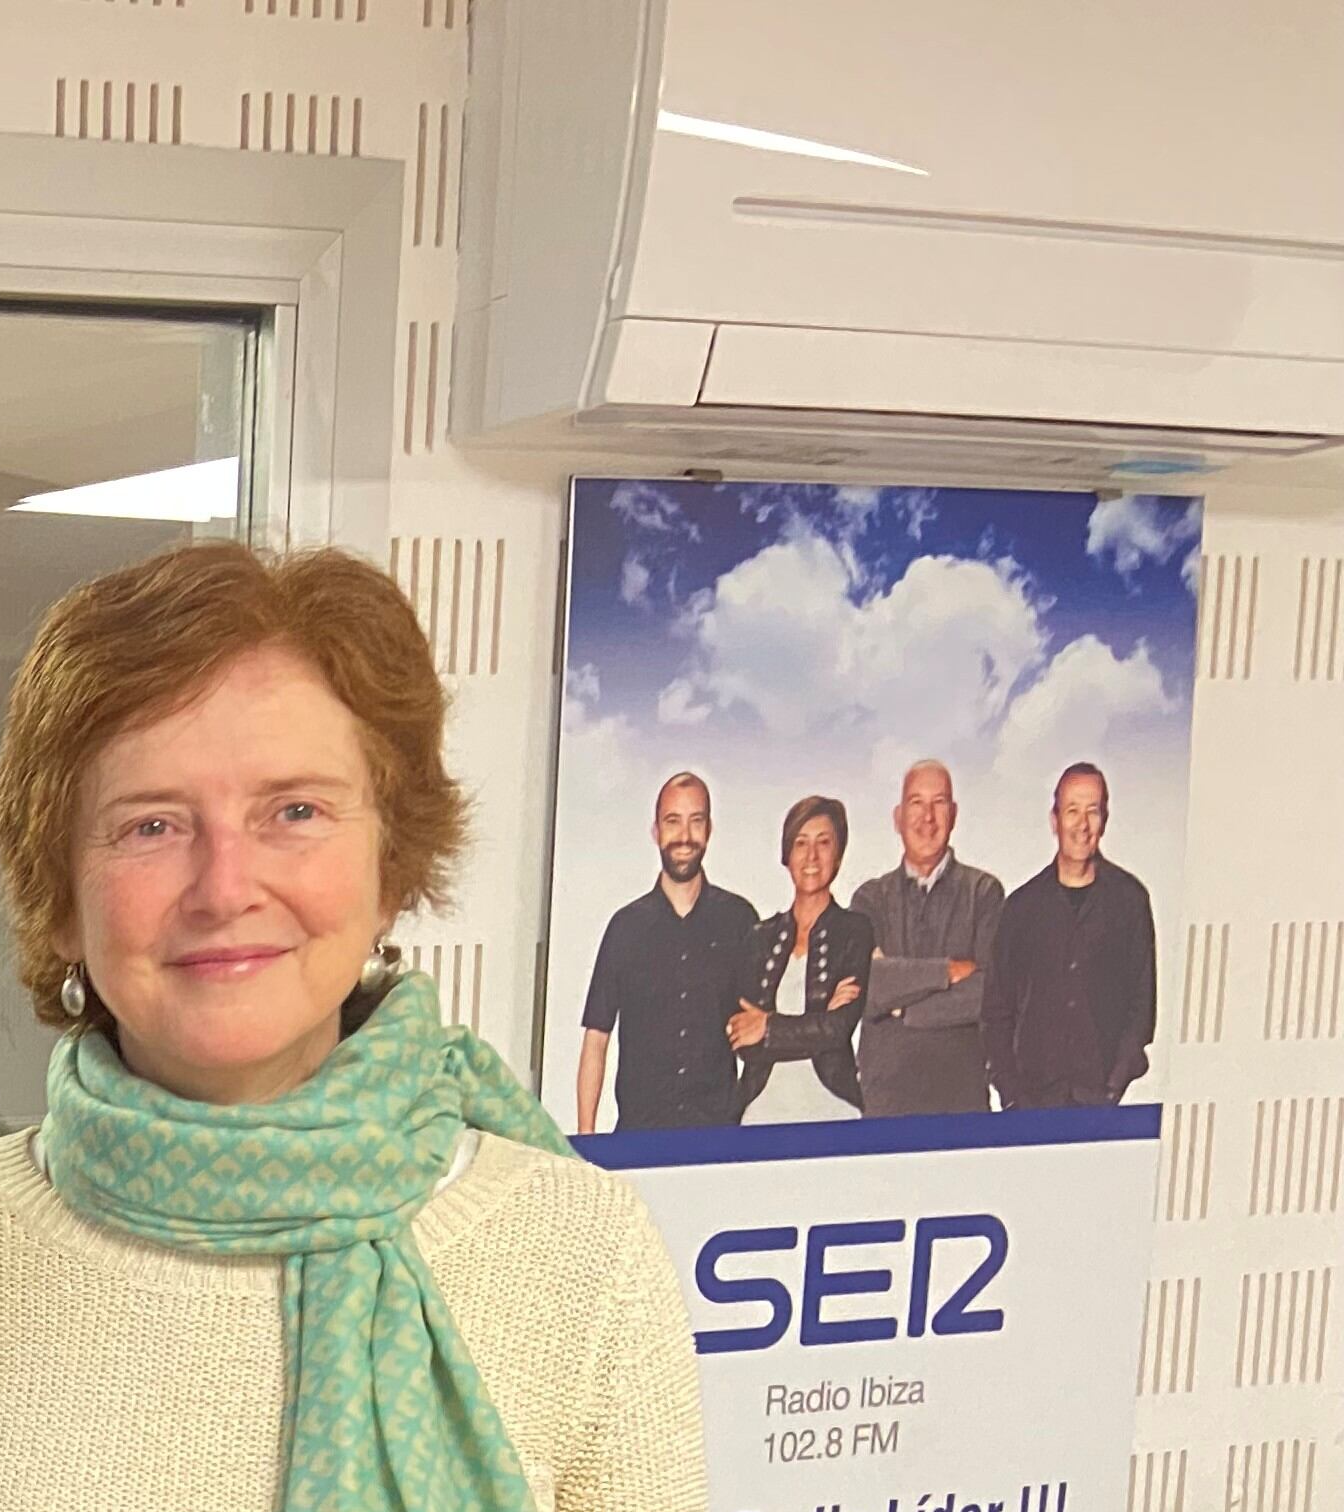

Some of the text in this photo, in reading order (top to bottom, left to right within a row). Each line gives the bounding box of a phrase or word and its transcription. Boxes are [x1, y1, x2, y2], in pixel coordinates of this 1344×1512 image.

[692, 1214, 1009, 1355] SER
[765, 1375, 925, 1416] Radio Ibiza
[763, 1420, 900, 1464] 102.8 FM
